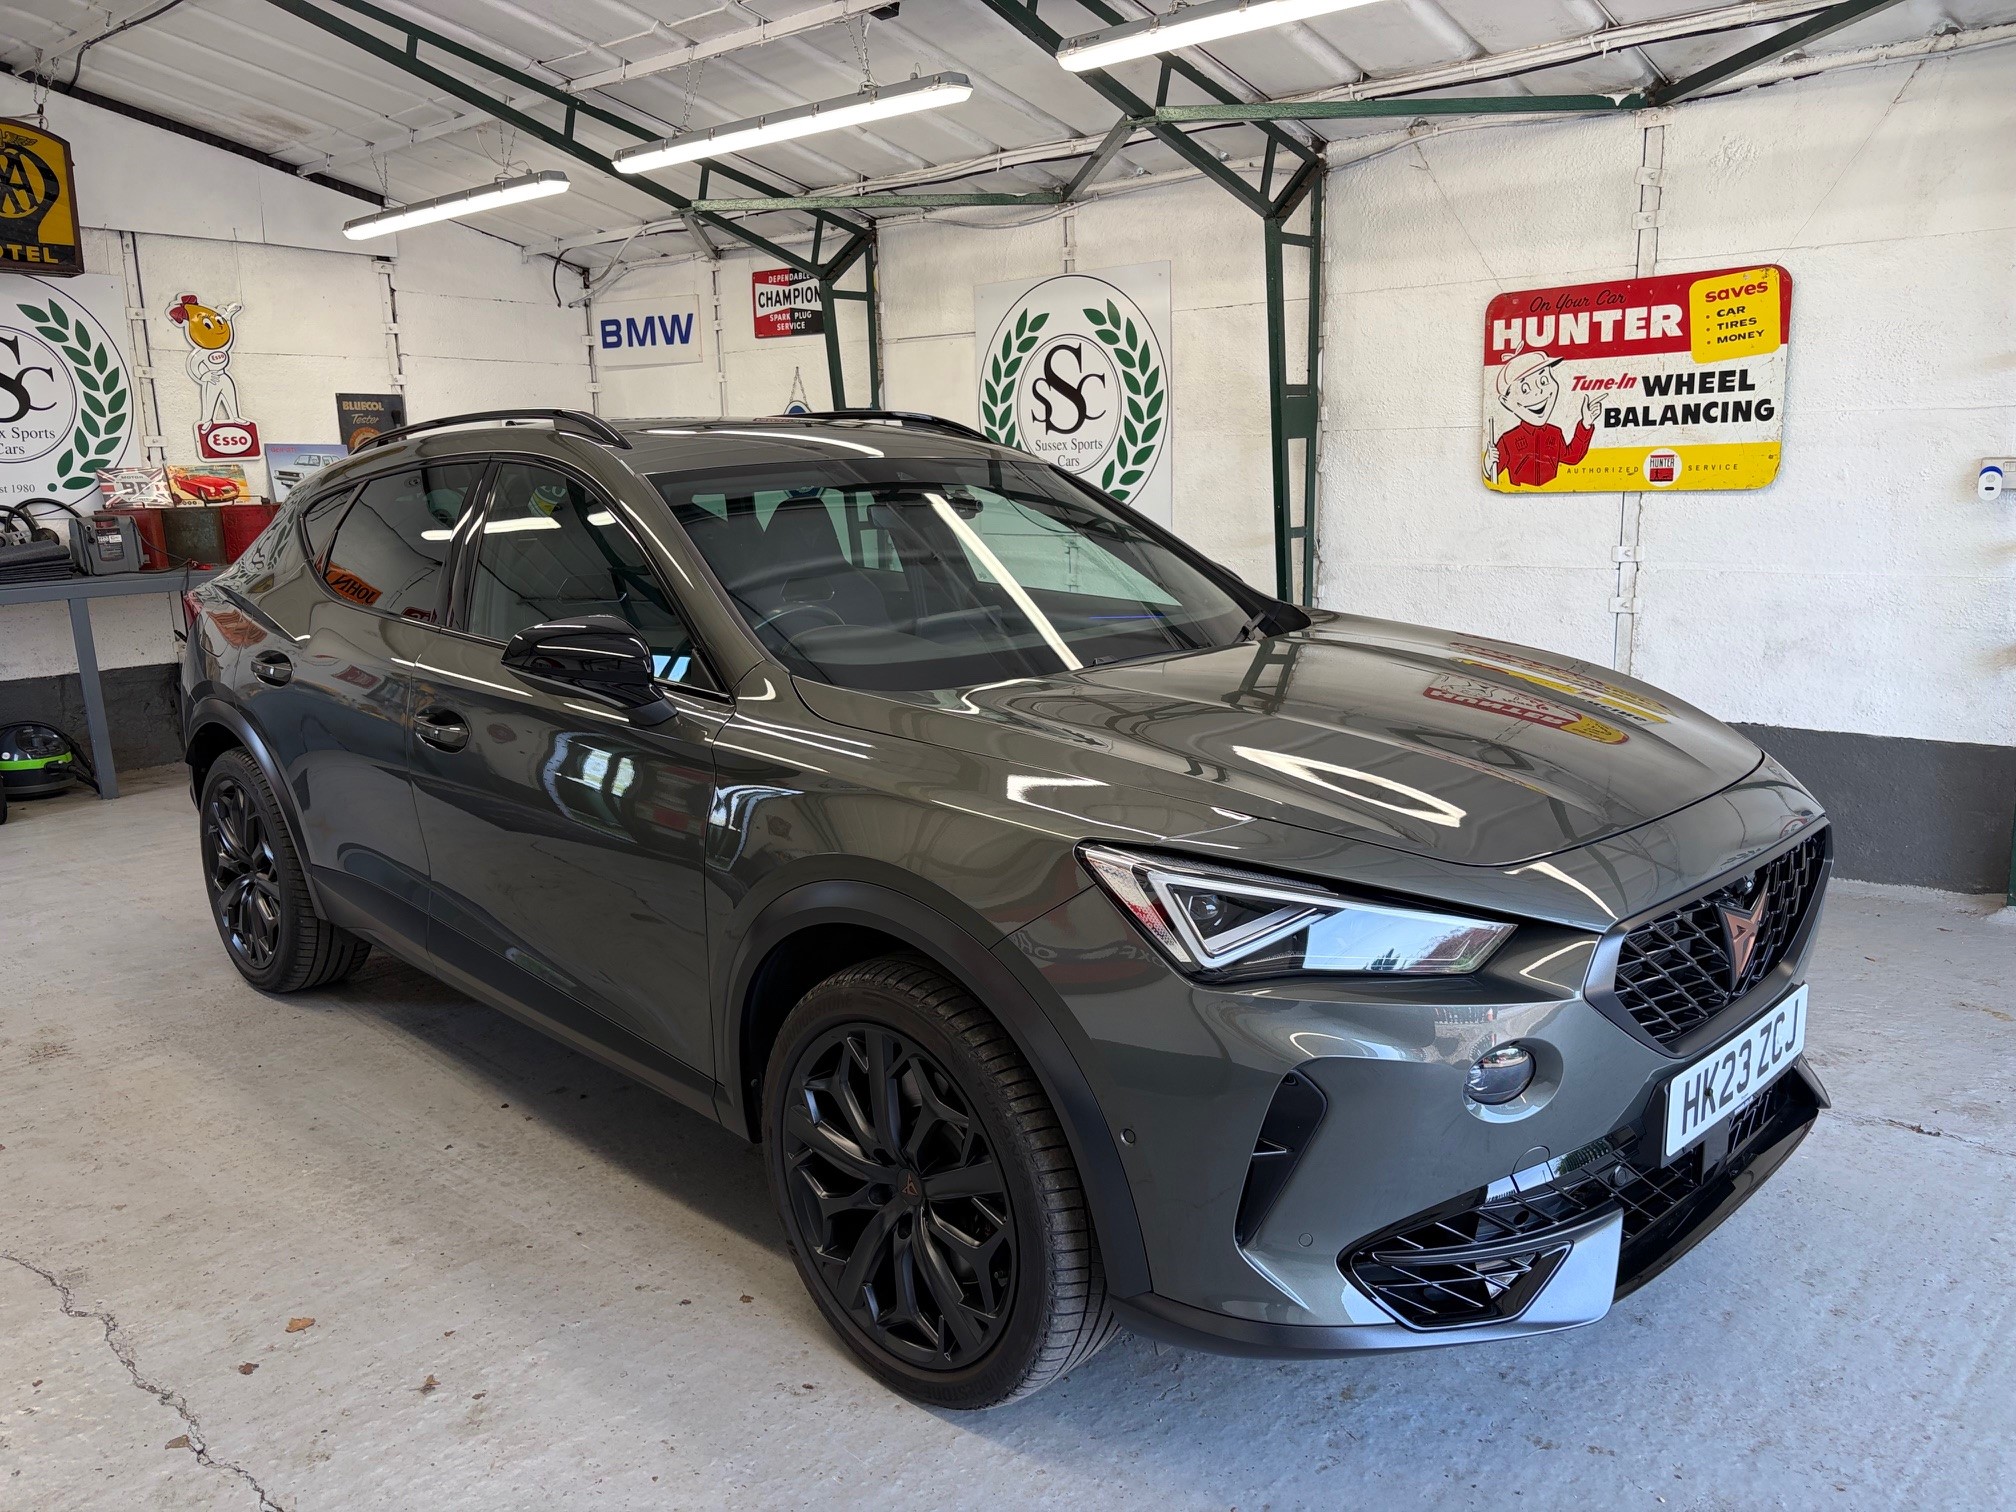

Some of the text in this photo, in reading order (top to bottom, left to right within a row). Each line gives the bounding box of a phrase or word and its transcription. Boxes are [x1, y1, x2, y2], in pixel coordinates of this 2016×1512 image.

[758, 285, 822, 308] CHAMPION
[1705, 280, 1768, 303] saves
[1530, 289, 1626, 313] On Your Car
[769, 311, 812, 322] SPARK PLUG
[1716, 305, 1746, 318] CAR
[601, 313, 694, 349] BMW
[776, 321, 806, 331] SERVICE
[1493, 304, 1683, 350] HUNTER
[1717, 317, 1758, 331] TIRES
[1717, 329, 1765, 344] MONEY
[1571, 368, 1756, 397] Tune-In WHEEL
[342, 400, 384, 411] BLUECOL
[351, 413, 379, 424] Tester
[1604, 398, 1774, 428] BALANCING
[12, 427, 56, 442] Sports
[213, 434, 248, 446] Esso
[1035, 438, 1103, 453] Sussex Sports
[1057, 455, 1080, 467] Cars
[1650, 457, 1674, 467] HUNTER
[1567, 466, 1639, 474] AUTHORIZED
[11, 484, 35, 493] 1980
[1682, 999, 1799, 1136] HK23 ZCJ
